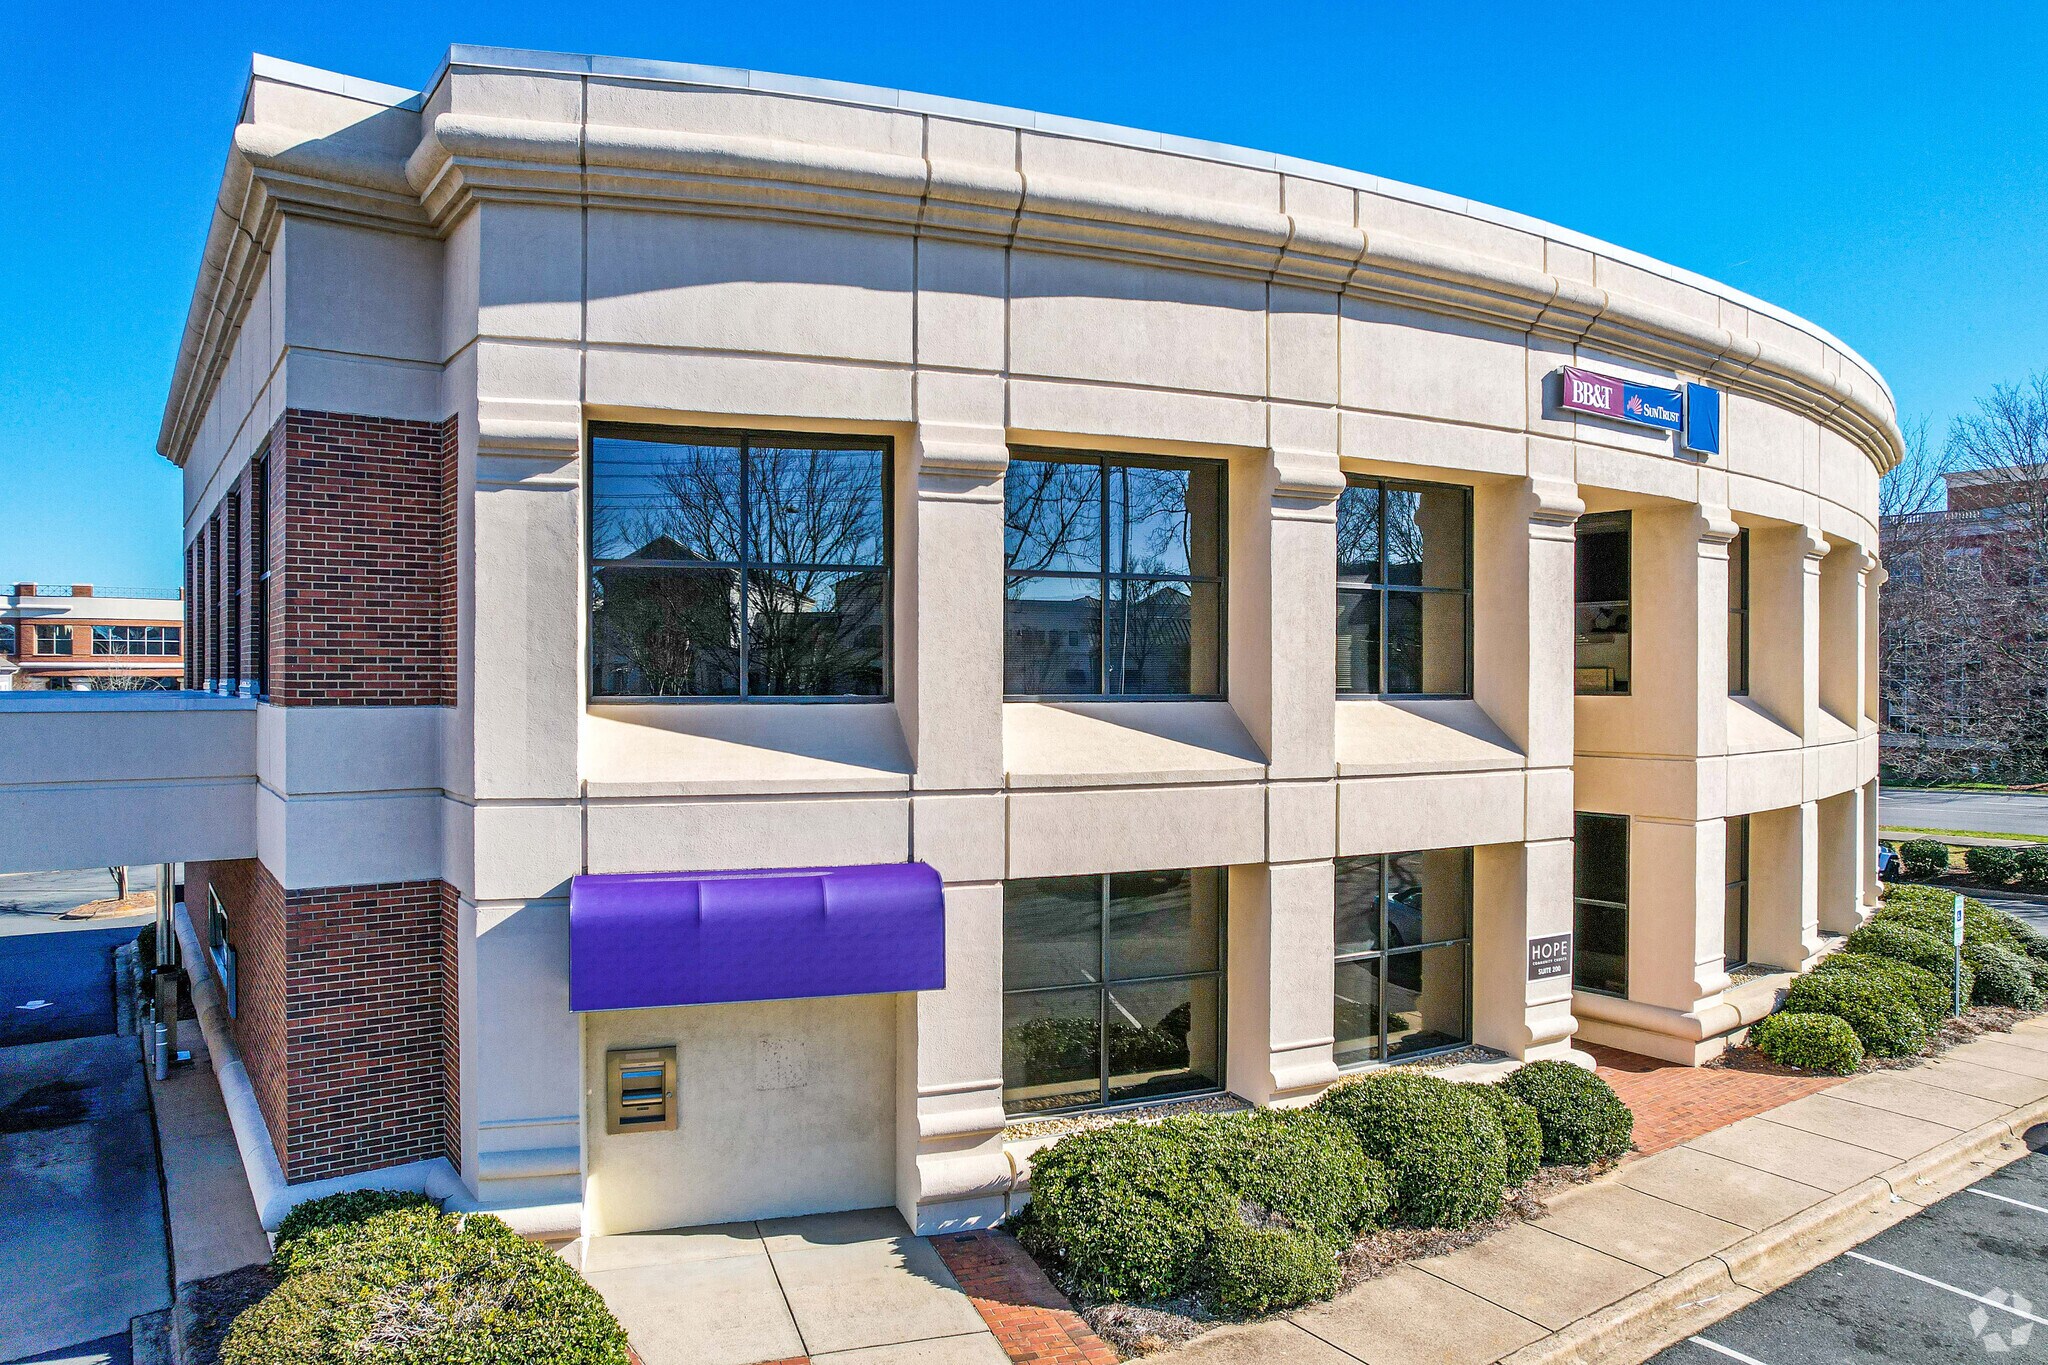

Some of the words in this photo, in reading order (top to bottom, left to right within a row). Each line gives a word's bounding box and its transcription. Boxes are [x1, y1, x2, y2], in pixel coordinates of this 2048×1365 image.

[1572, 379, 1613, 410] BB&T
[1532, 941, 1568, 960] HOPE
[1538, 967, 1551, 975] SUITE
